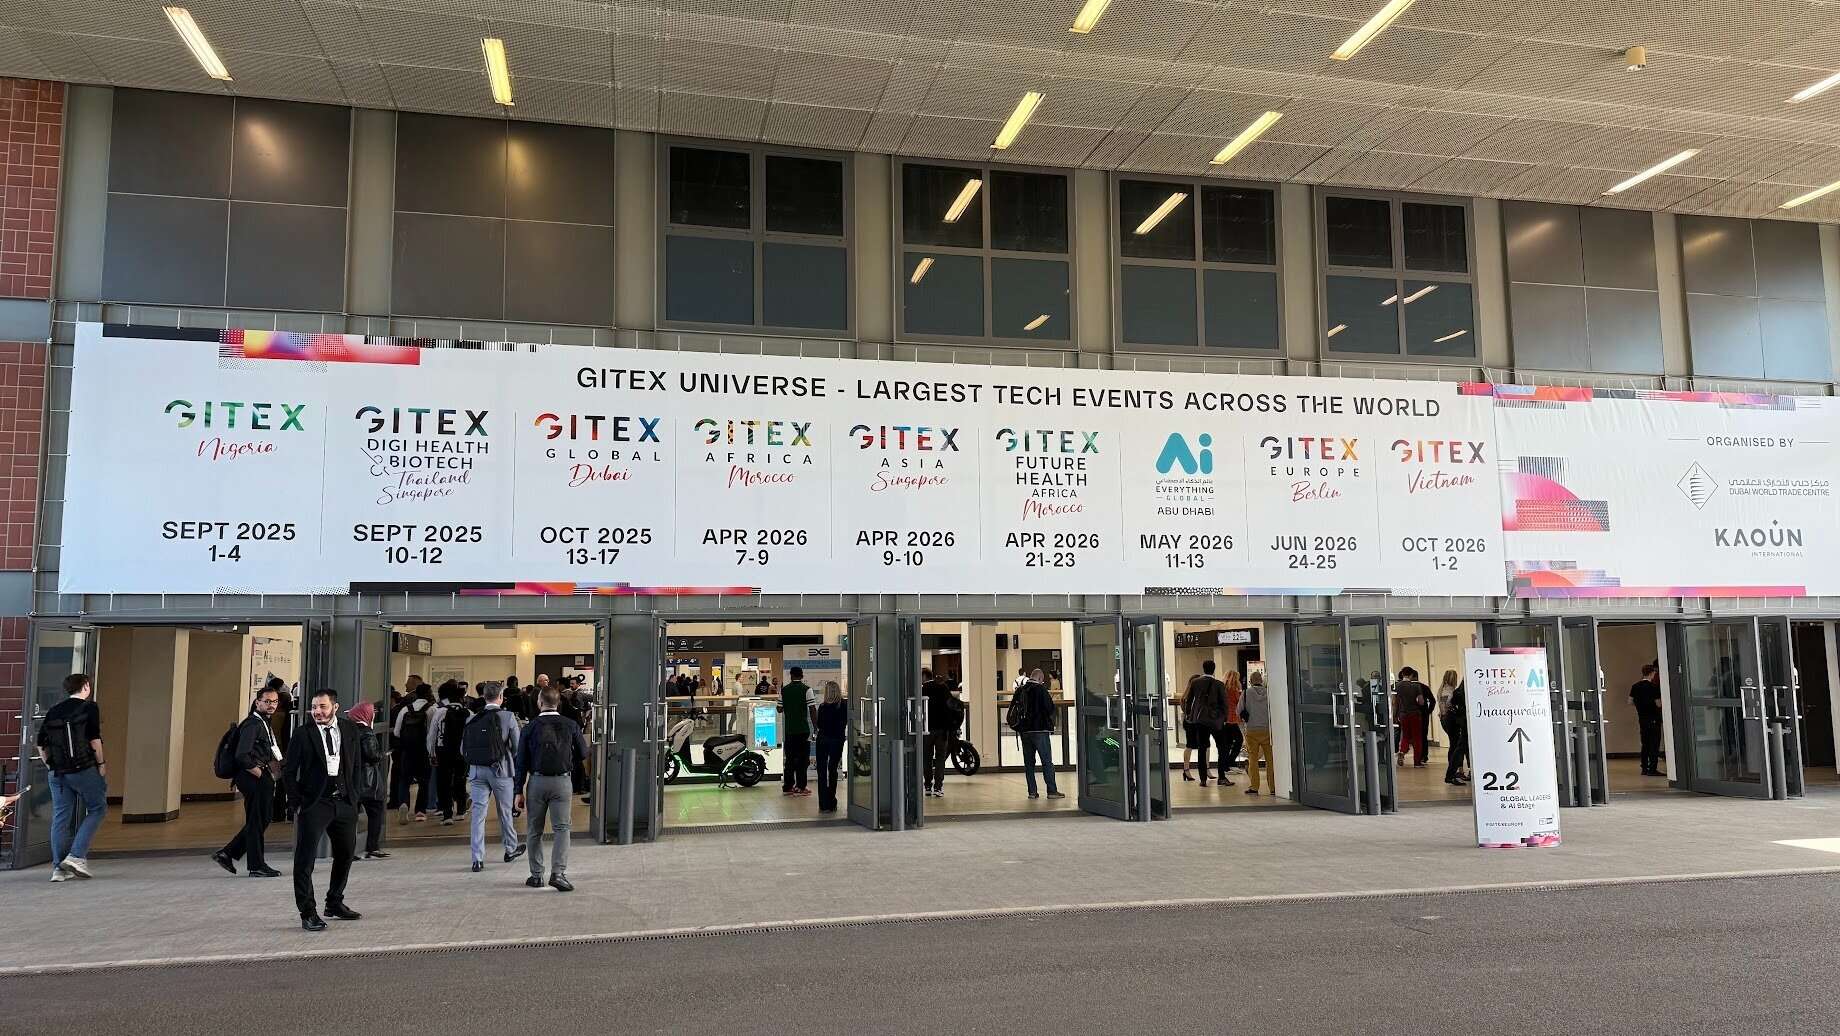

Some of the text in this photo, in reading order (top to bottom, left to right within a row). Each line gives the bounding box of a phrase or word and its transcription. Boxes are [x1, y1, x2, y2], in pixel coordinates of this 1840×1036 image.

[577, 367, 666, 391] GITEX
[680, 373, 825, 397] UNIVERSE
[858, 380, 982, 402] LARGEST
[993, 385, 1060, 405] TECH
[1073, 388, 1173, 409] EVENTS
[1184, 392, 1286, 412] ACROSS
[1297, 395, 1343, 413] THE
[1353, 397, 1439, 416] WORLD
[165, 400, 306, 431] GITEX
[356, 406, 488, 436] GITEX
[535, 413, 660, 442] GITEX
[694, 419, 811, 446] GITEX
[849, 425, 959, 451] GITEX
[996, 429, 1099, 453] GITEX
[1706, 436, 1795, 448] ORGANISED BY
[198, 438, 277, 463] Nigeria
[368, 439, 488, 454] DIGI HEALTH
[1260, 436, 1358, 460] GITEX
[1391, 440, 1486, 464] GITEX
[546, 449, 660, 461] GLOBAL
[705, 451, 813, 465] AFRICA
[881, 458, 943, 468] ASIA
[390, 456, 472, 471] BIOTECH
[1016, 456, 1087, 472] FUTURE
[393, 470, 472, 489] Thailand
[569, 464, 632, 487] Dubai
[729, 463, 794, 488] Morocco
[1017, 472, 1086, 486] HEALTH
[1271, 467, 1359, 477] EUROPE
[871, 471, 948, 491] Singapore
[1155, 485, 1214, 493] EVERYTHING
[1408, 469, 1474, 494] Vietnam
[376, 485, 455, 505] Singapore
[1032, 489, 1077, 498] AFRICA
[1289, 481, 1341, 503] Berlin
[1729, 488, 1753, 496] DUBAI
[1752, 488, 1778, 496] WORLD
[1023, 496, 1087, 521] Morocco
[1157, 506, 1214, 516] ABU DHABI
[162, 521, 295, 540] SEPT 2025
[354, 524, 482, 542] SEPT 2025
[541, 527, 651, 544] OCT 2025
[703, 529, 807, 545] APR 2026
[856, 531, 954, 546] APR 2026
[1005, 533, 1099, 548] APR 2026
[1141, 534, 1233, 549] MAY 2026
[1271, 536, 1356, 551] JUN 2026
[1402, 537, 1485, 552] OCT 2026
[209, 545, 241, 562] 1-4
[385, 547, 442, 563] 10-12
[567, 548, 619, 564] 13-17
[736, 550, 768, 565] 7-9
[884, 551, 923, 566] 9-10
[1026, 552, 1075, 567] 21-23
[1166, 554, 1204, 568] 11-13
[1289, 555, 1336, 569] 24-25
[1433, 556, 1457, 570] 1-2
[1474, 669, 1515, 678] GITEX
[1475, 700, 1548, 725] Inauguration
[1482, 771, 1519, 791] 2.2
